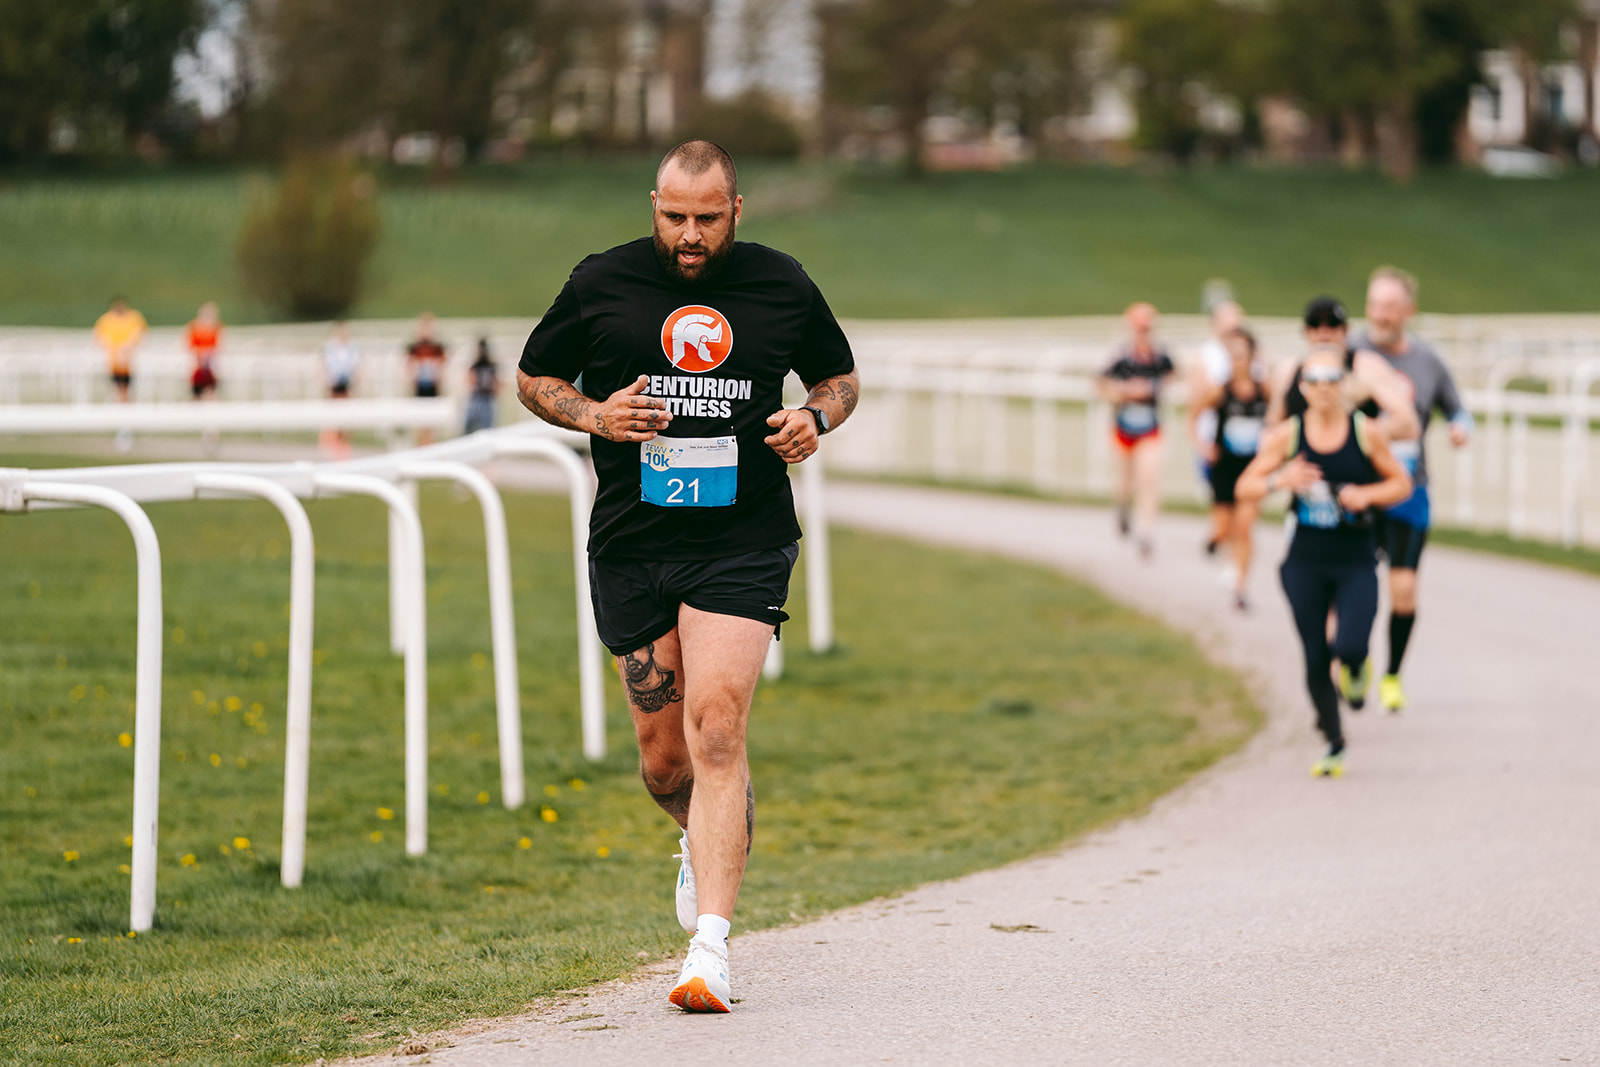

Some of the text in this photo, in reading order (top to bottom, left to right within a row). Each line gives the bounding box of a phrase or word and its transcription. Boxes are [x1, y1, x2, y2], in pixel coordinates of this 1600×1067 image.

[655, 397, 732, 418] ITNESS
[646, 443, 667, 454] TEWV
[645, 452, 670, 467] 10k
[666, 478, 699, 503] 21
